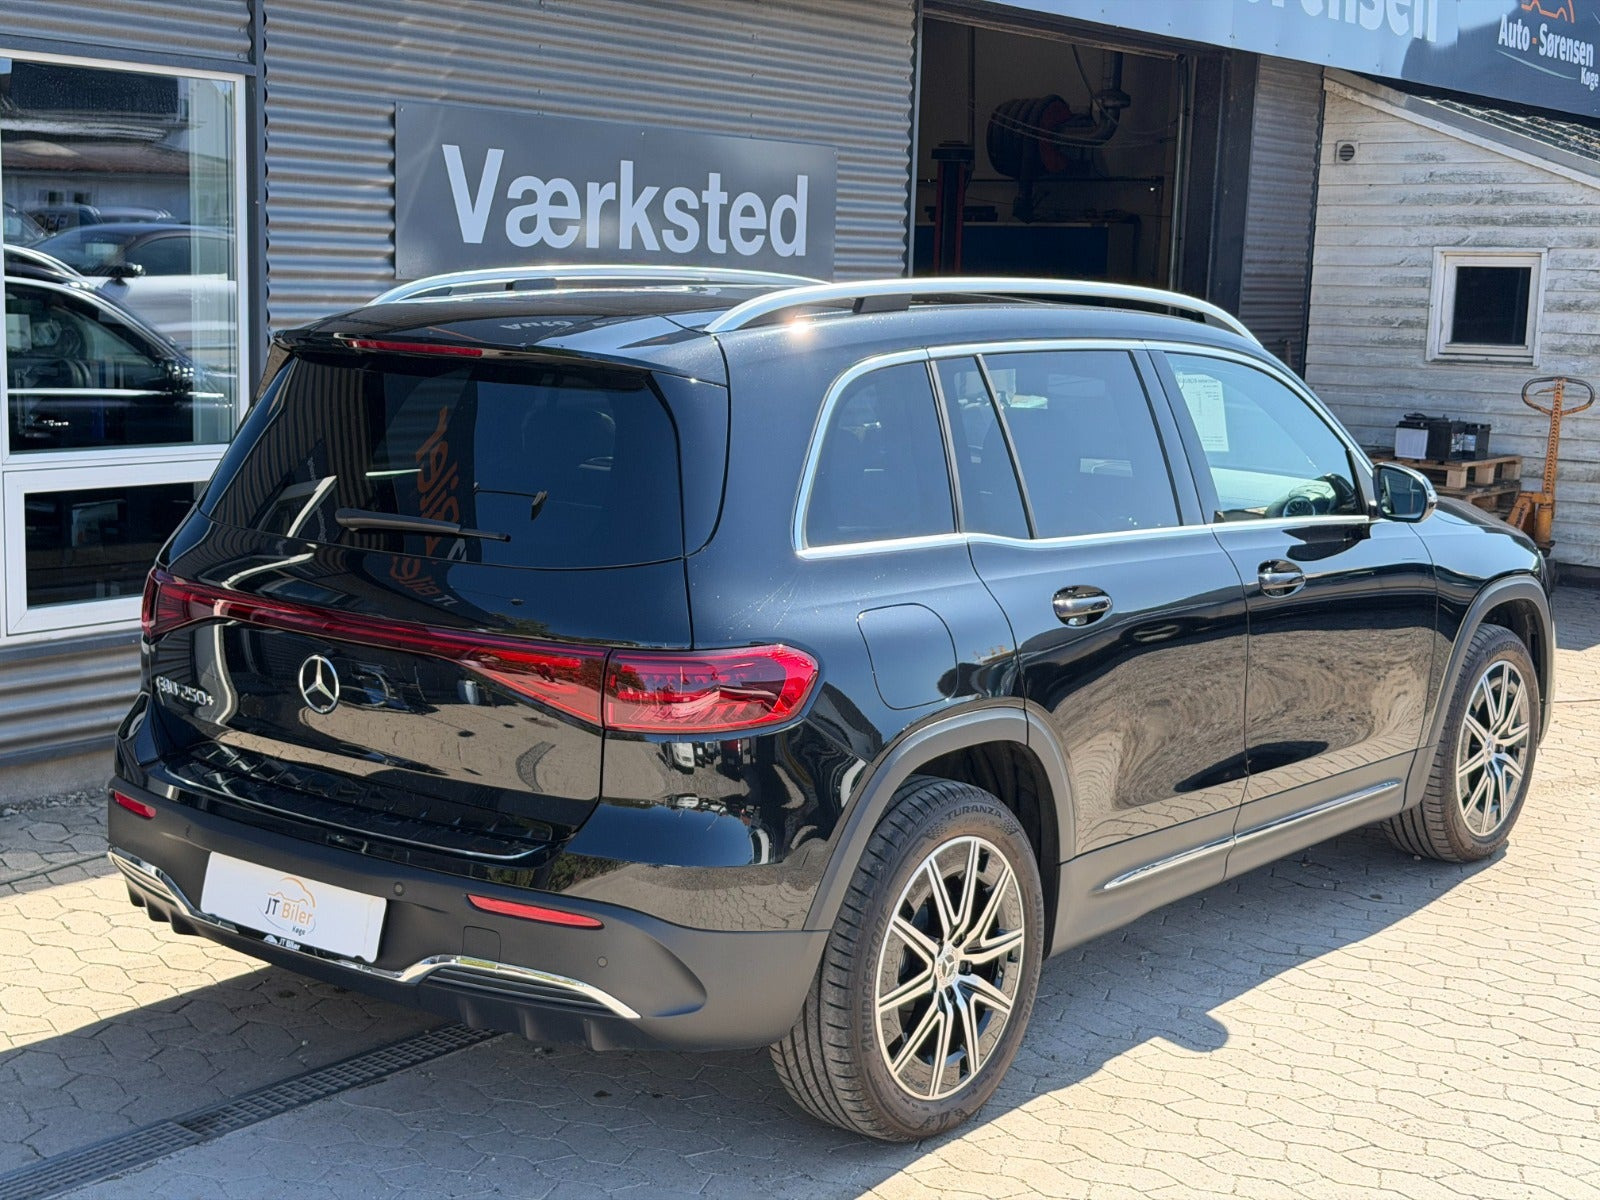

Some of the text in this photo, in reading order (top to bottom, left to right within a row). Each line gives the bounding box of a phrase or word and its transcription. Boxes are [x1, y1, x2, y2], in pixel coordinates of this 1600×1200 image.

[1498, 13, 1530, 52] Auto
[1539, 23, 1594, 67] Sørensen
[1581, 67, 1599, 91] Køge
[442, 144, 809, 257] Værksted
[945, 805, 1002, 819] TURANZA
[265, 898, 313, 924] JT Biler
[286, 939, 300, 950] Biler
